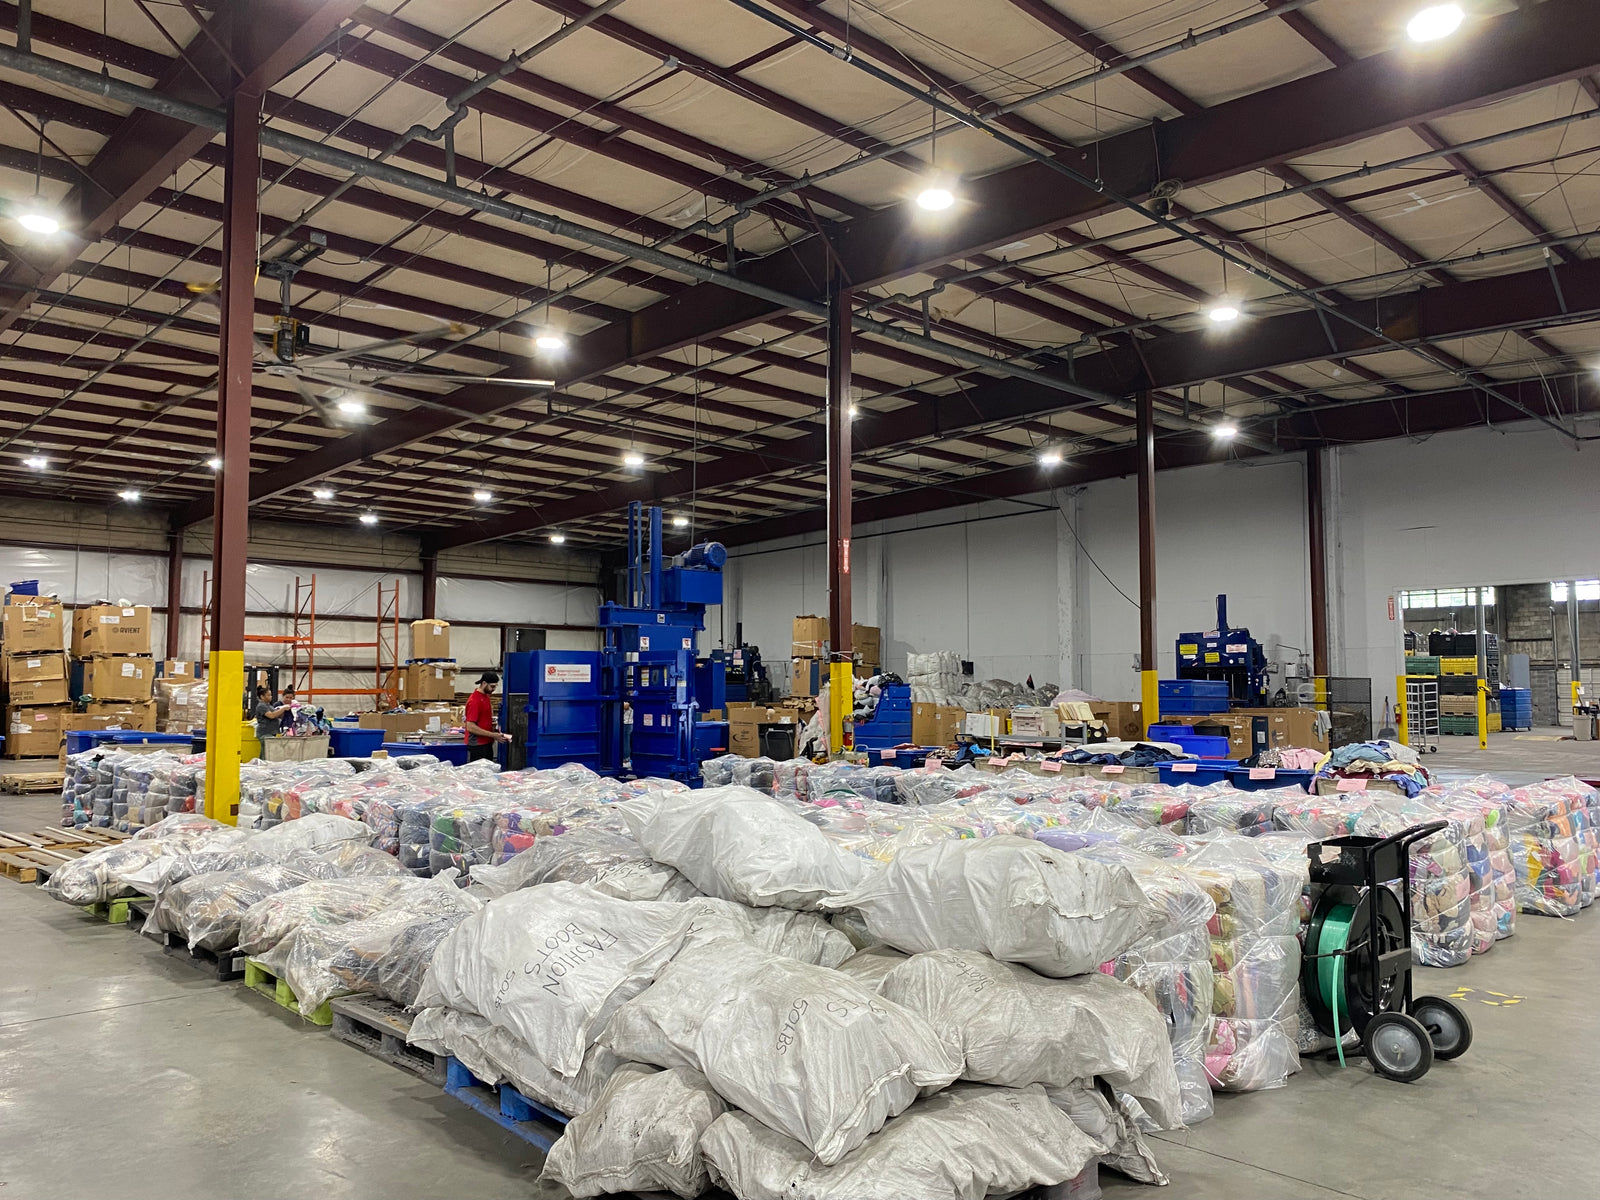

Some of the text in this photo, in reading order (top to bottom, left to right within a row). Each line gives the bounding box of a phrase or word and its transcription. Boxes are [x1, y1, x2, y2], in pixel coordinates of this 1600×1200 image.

[523, 922, 584, 975] BOOTS
[542, 926, 619, 997] FASHION
[775, 997, 809, 1056] 50LBS
